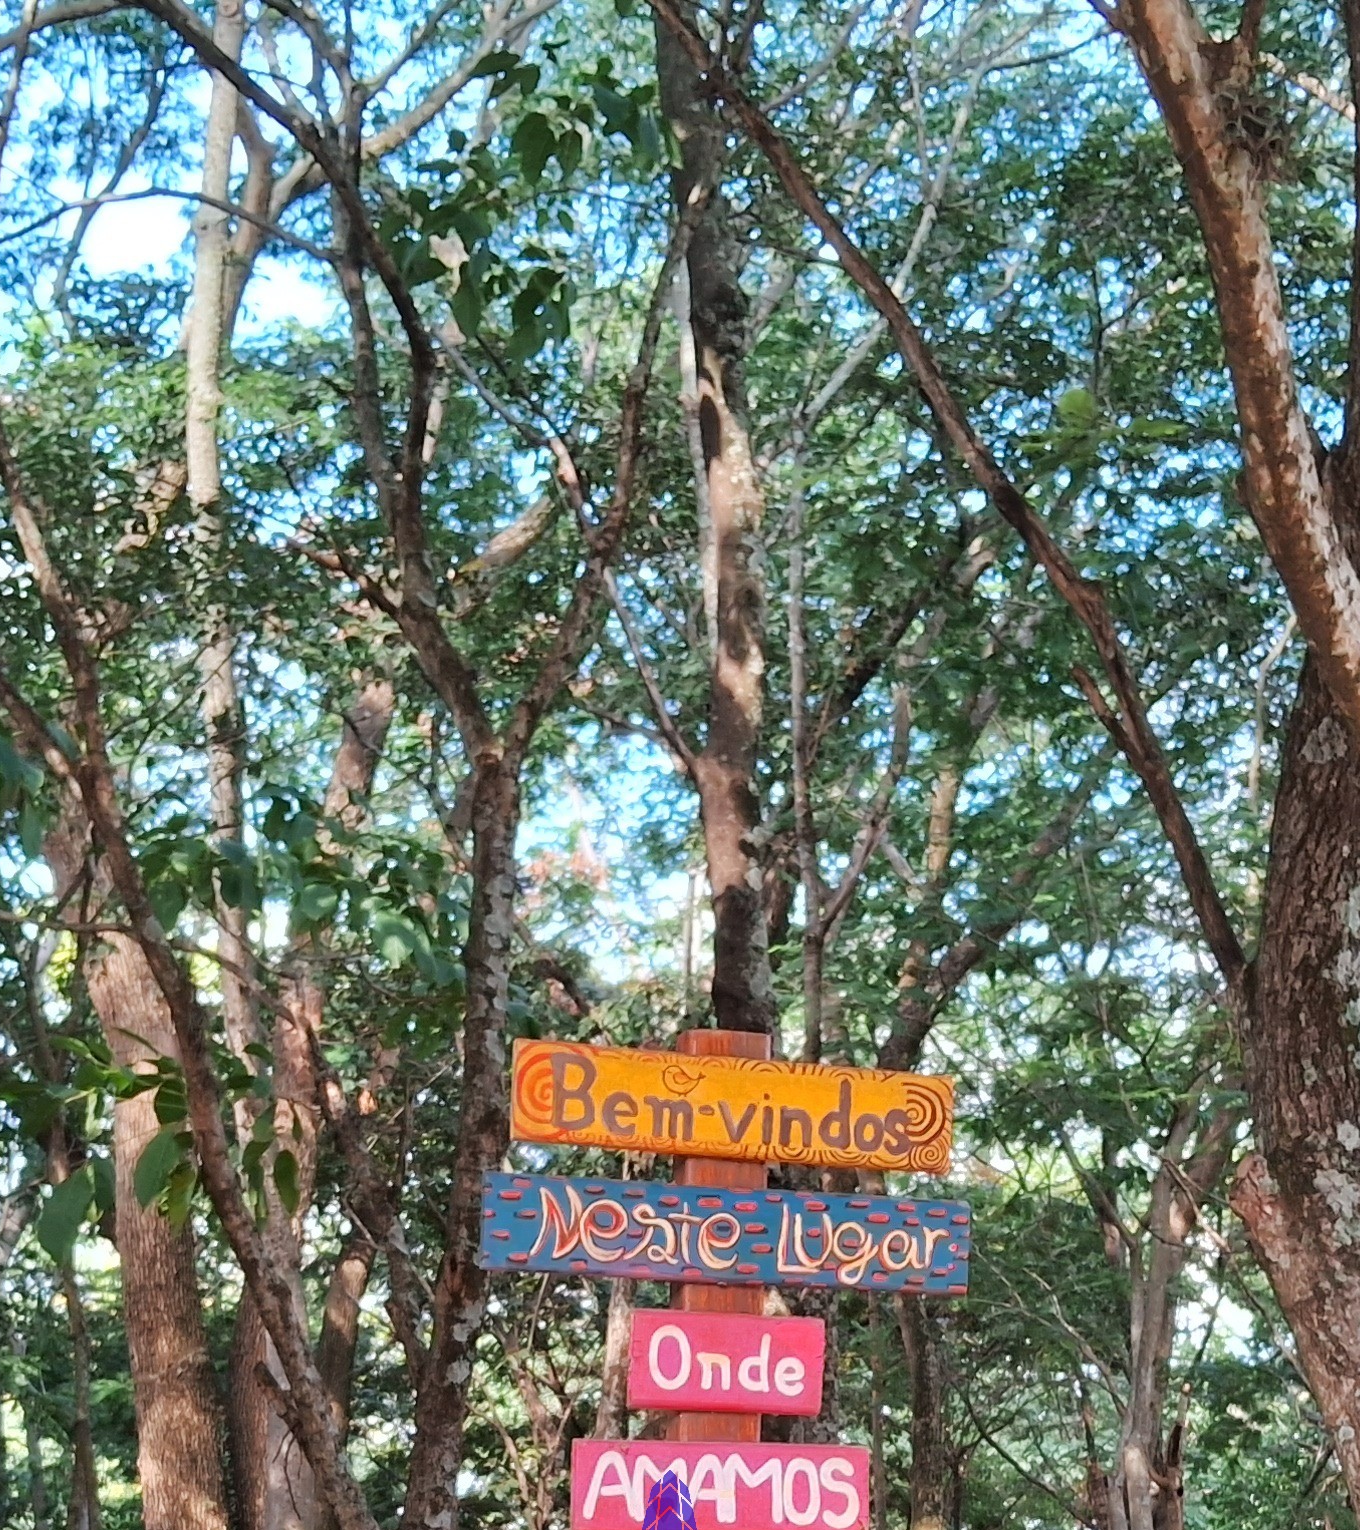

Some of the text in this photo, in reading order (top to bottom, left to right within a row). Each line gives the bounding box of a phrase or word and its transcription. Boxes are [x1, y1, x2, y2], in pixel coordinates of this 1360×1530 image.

[549, 1051, 913, 1156] Bem-vindos
[530, 1184, 950, 1286] Neste Lugar
[648, 1324, 805, 1397] Onde
[583, 1451, 860, 1529] AMAMOS
